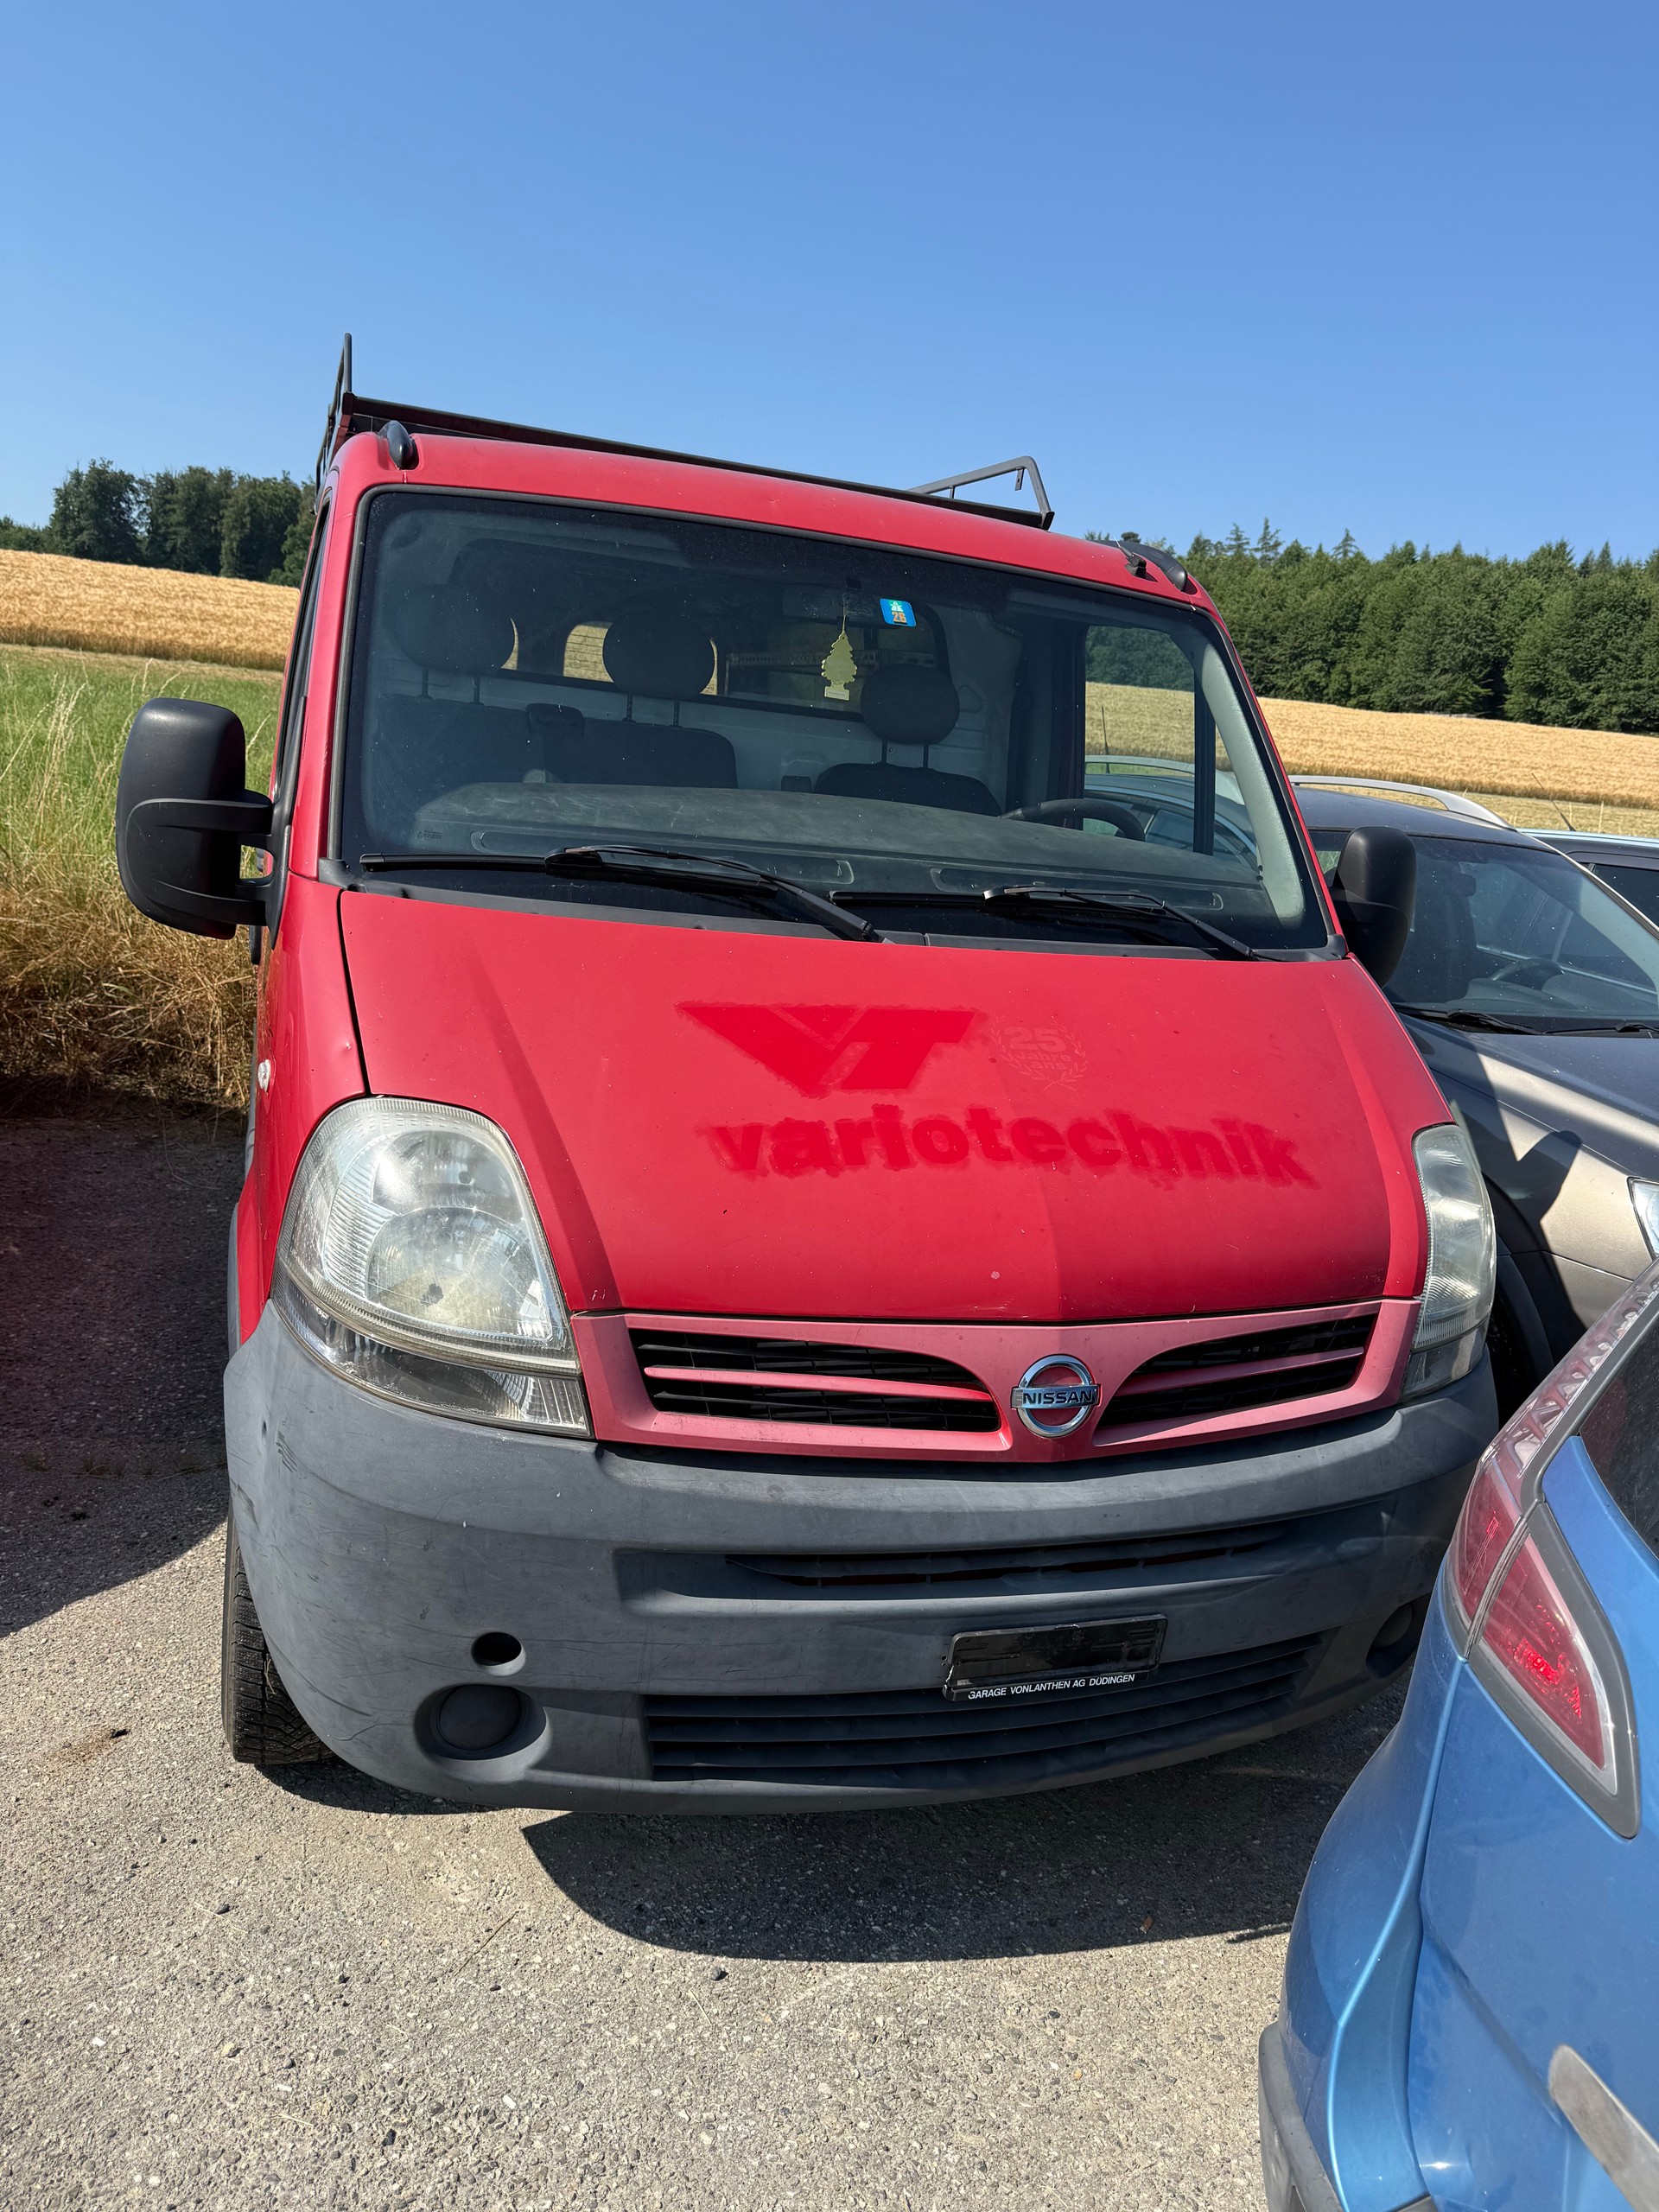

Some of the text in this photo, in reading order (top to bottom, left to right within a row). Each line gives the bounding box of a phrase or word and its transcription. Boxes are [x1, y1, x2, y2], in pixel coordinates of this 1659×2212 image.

[1004, 1026, 1066, 1052] 25
[1015, 1052, 1071, 1062] Jahre
[710, 1105, 1313, 1185] variotechnik
[1022, 1390, 1093, 1405] NISSAN
[968, 1688, 1007, 1700] GARAGE
[1010, 1681, 1071, 1694] VONLANTHEN
[1072, 1679, 1085, 1688] AG
